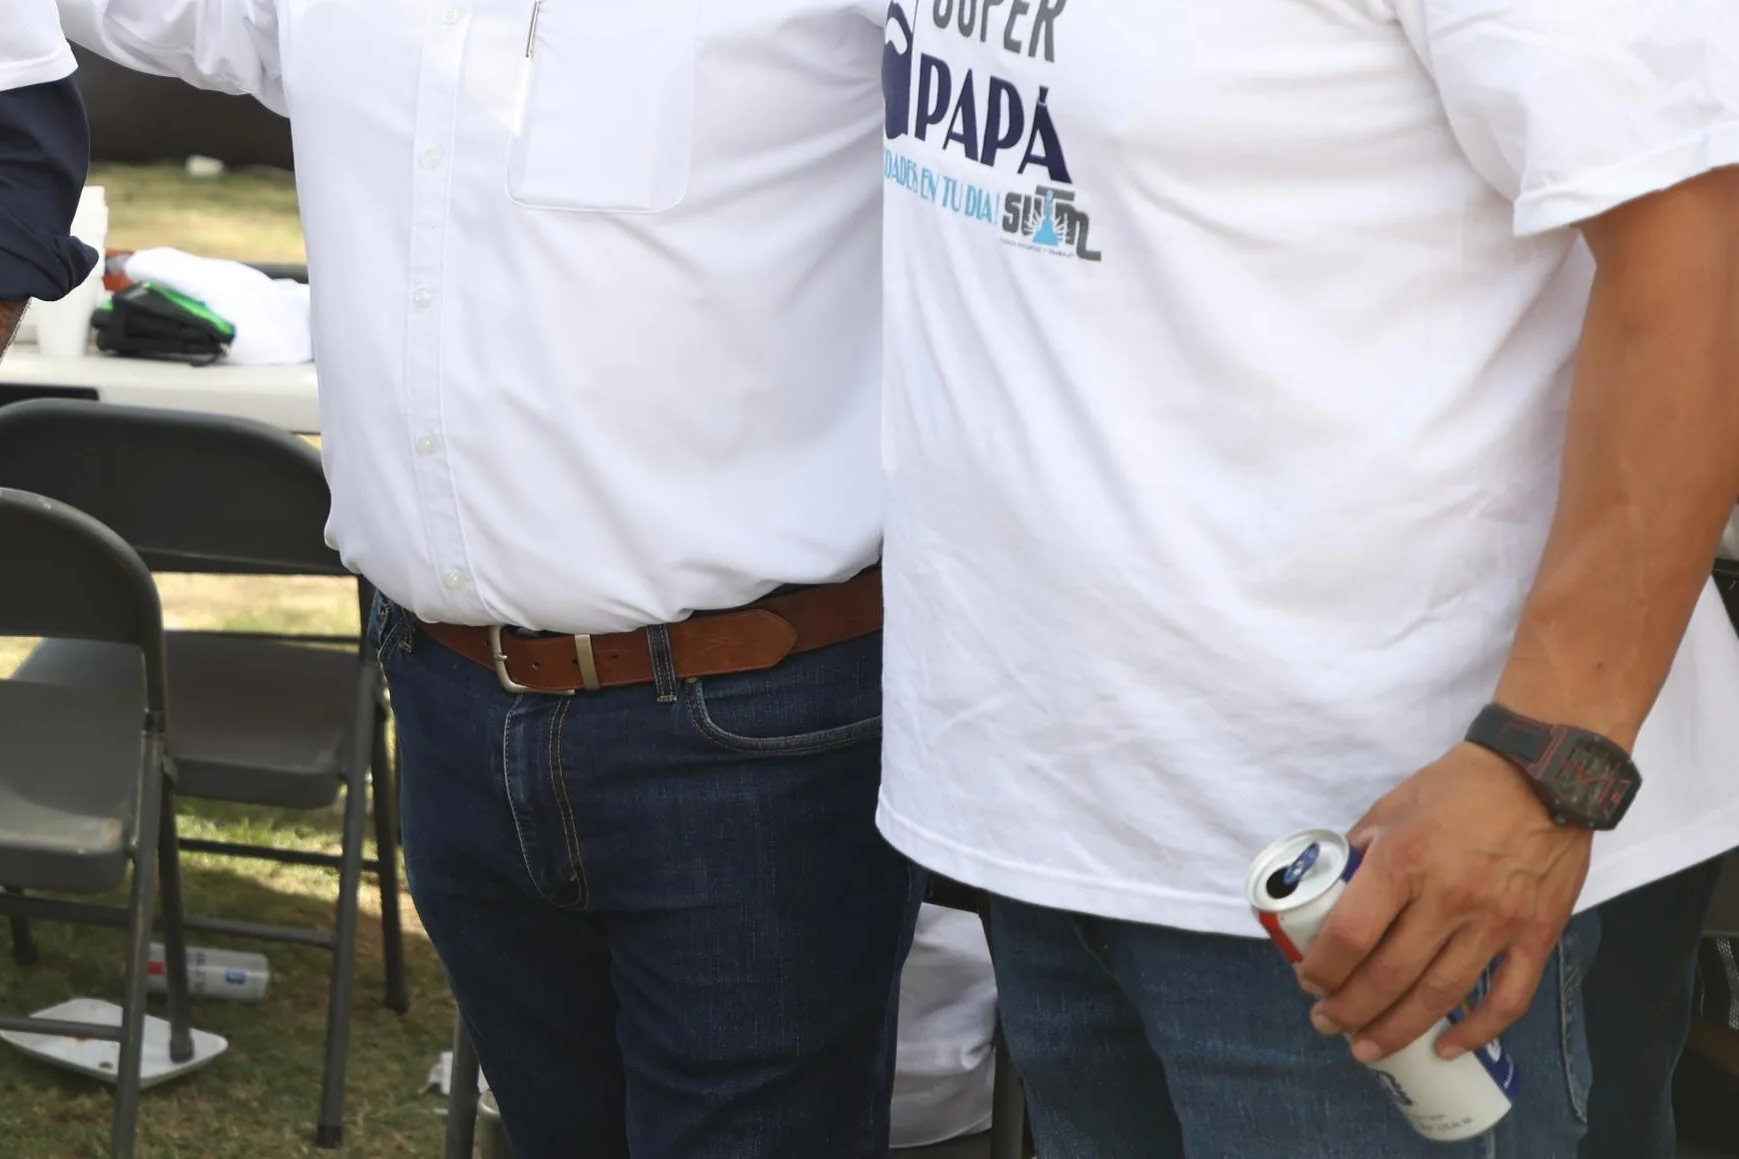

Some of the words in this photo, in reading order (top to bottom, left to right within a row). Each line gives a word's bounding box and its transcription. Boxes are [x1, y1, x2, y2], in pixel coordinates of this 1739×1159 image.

[914, 52, 1073, 185] PAPÁ
[883, 147, 918, 194] DADES
[920, 167, 940, 203] EN
[942, 175, 964, 213] TU
